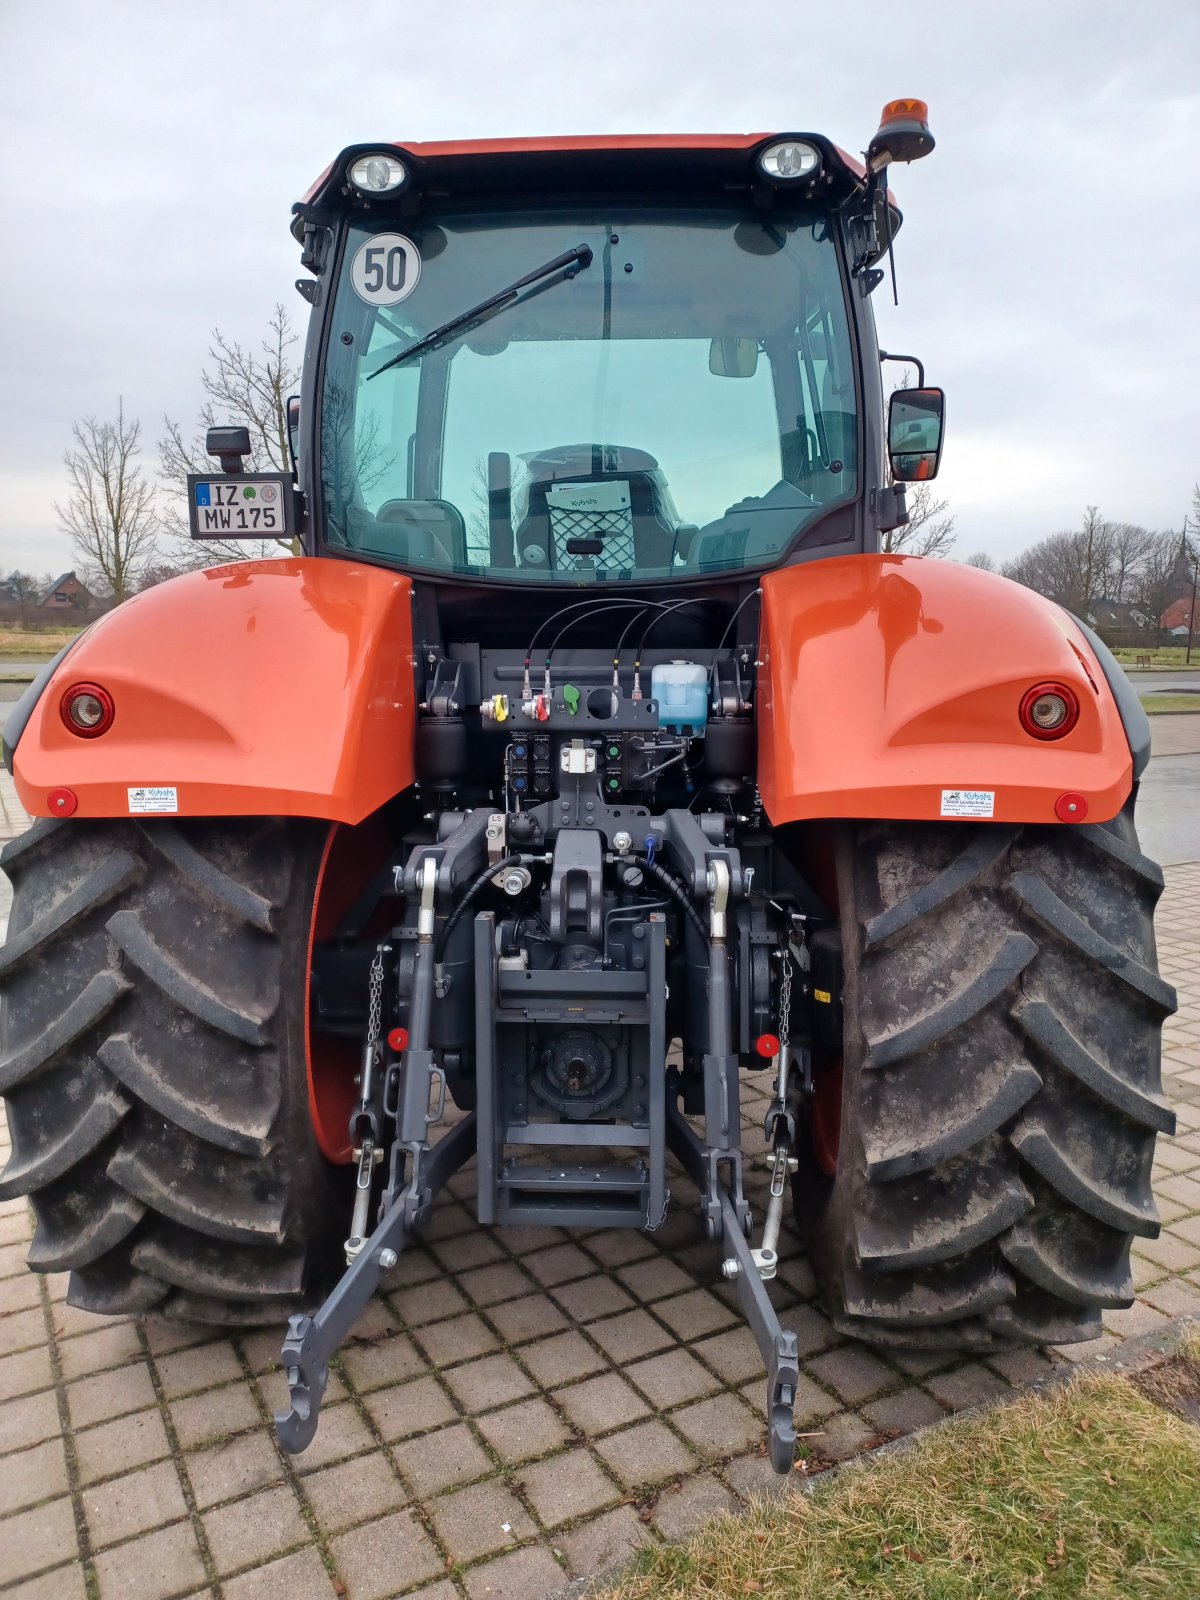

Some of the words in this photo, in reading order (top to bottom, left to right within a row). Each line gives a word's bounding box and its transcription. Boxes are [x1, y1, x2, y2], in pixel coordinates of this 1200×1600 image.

[364, 246, 407, 293] 50
[215, 485, 239, 506] IZ
[571, 498, 598, 506] Kubota
[204, 508, 231, 529] MW
[236, 507, 276, 528] 175
[148, 788, 174, 797] Kubota
[964, 792, 992, 801] Kubota
